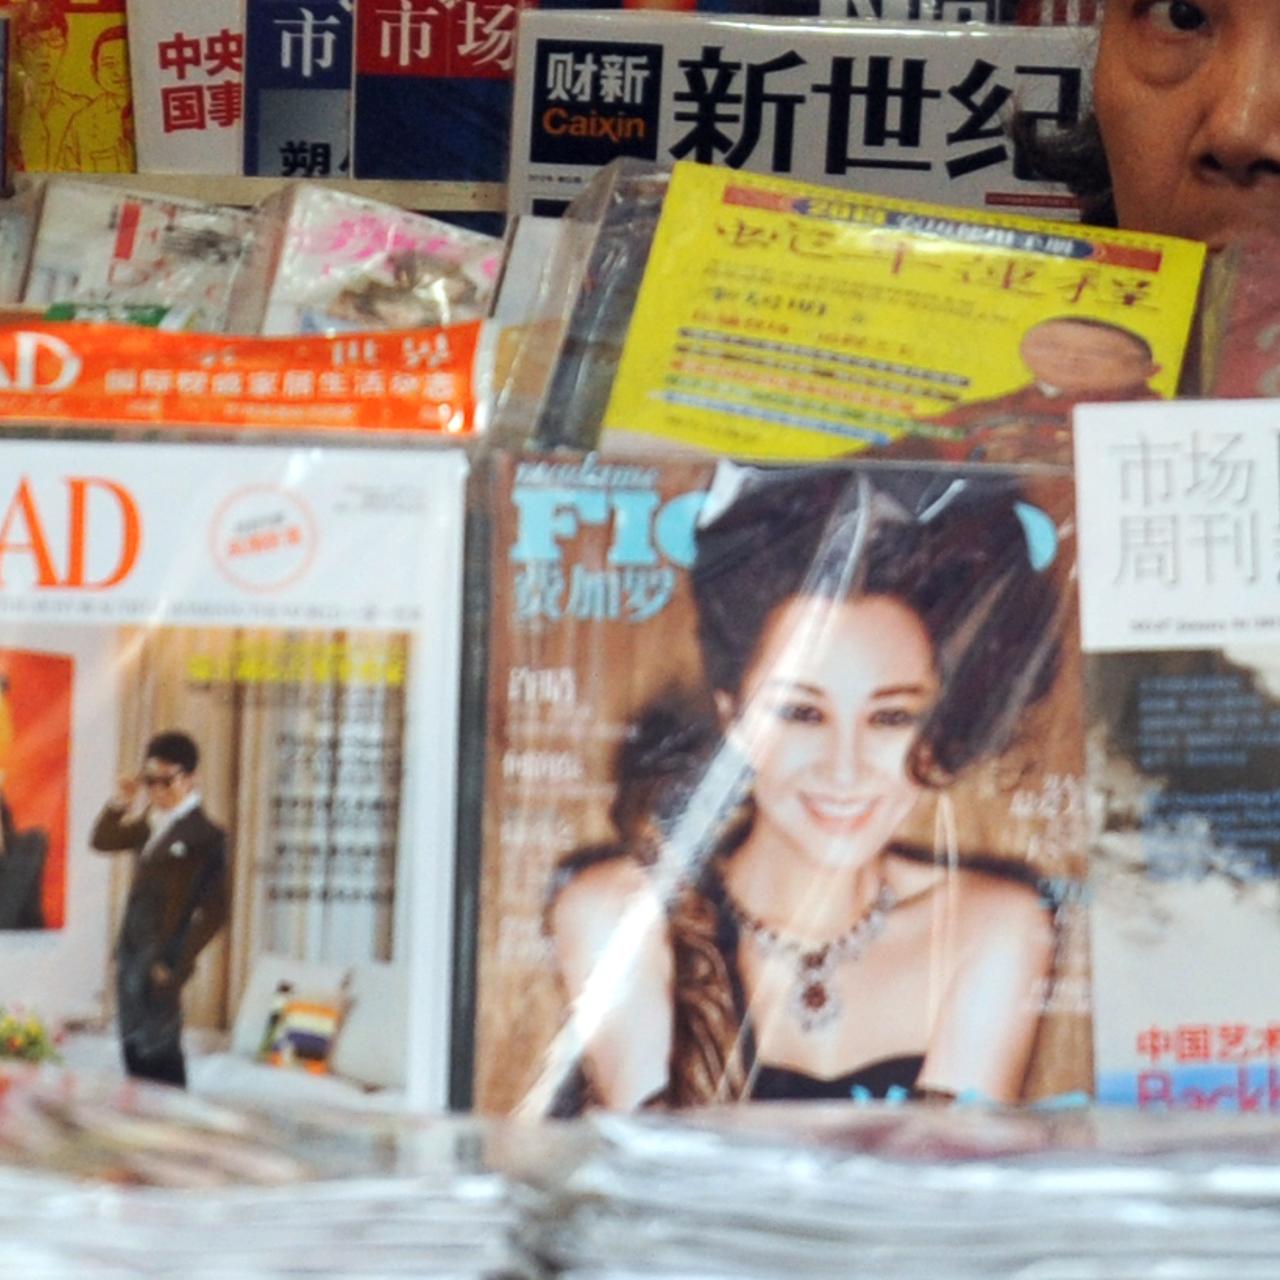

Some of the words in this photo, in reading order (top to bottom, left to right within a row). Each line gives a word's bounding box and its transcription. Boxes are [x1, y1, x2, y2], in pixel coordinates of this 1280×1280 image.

[545, 50, 651, 106] 财新
[541, 106, 647, 142] Caixin
[669, 44, 1084, 182] 新世纪
[1110, 432, 1257, 508] 市场
[1112, 512, 1261, 588] 周刊
[515, 564, 676, 622] 费加罗
